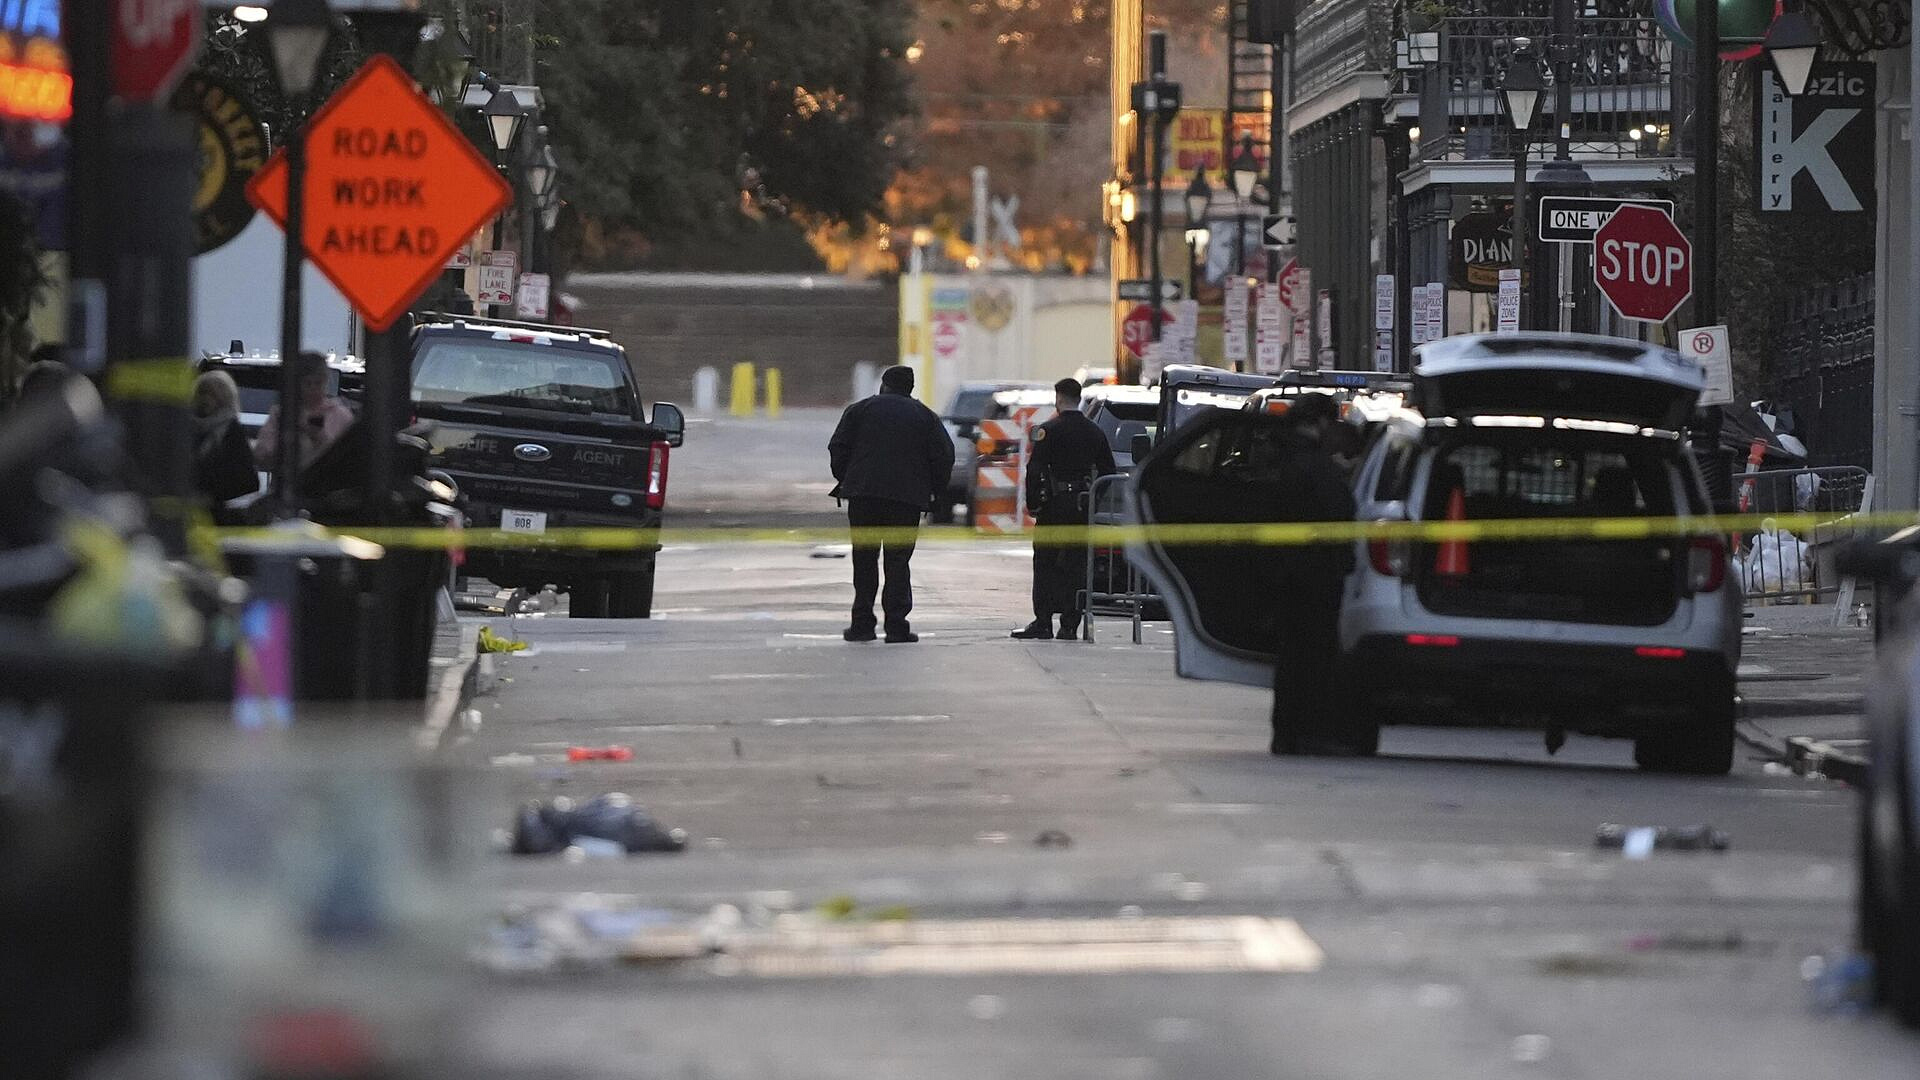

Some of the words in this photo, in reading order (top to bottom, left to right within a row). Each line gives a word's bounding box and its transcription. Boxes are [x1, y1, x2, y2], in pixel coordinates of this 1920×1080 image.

[1807, 72, 1866, 97] ezic
[333, 126, 428, 159] ROAD
[332, 176, 427, 207] WORK
[1555, 211, 1590, 228] ONE
[321, 224, 440, 257] AHEAD
[1463, 237, 1513, 264] DIAN
[1601, 238, 1684, 287] STOP
[1500, 296, 1519, 307] POLICE
[1501, 308, 1517, 319] ZONE
[573, 449, 625, 465] AGENT
